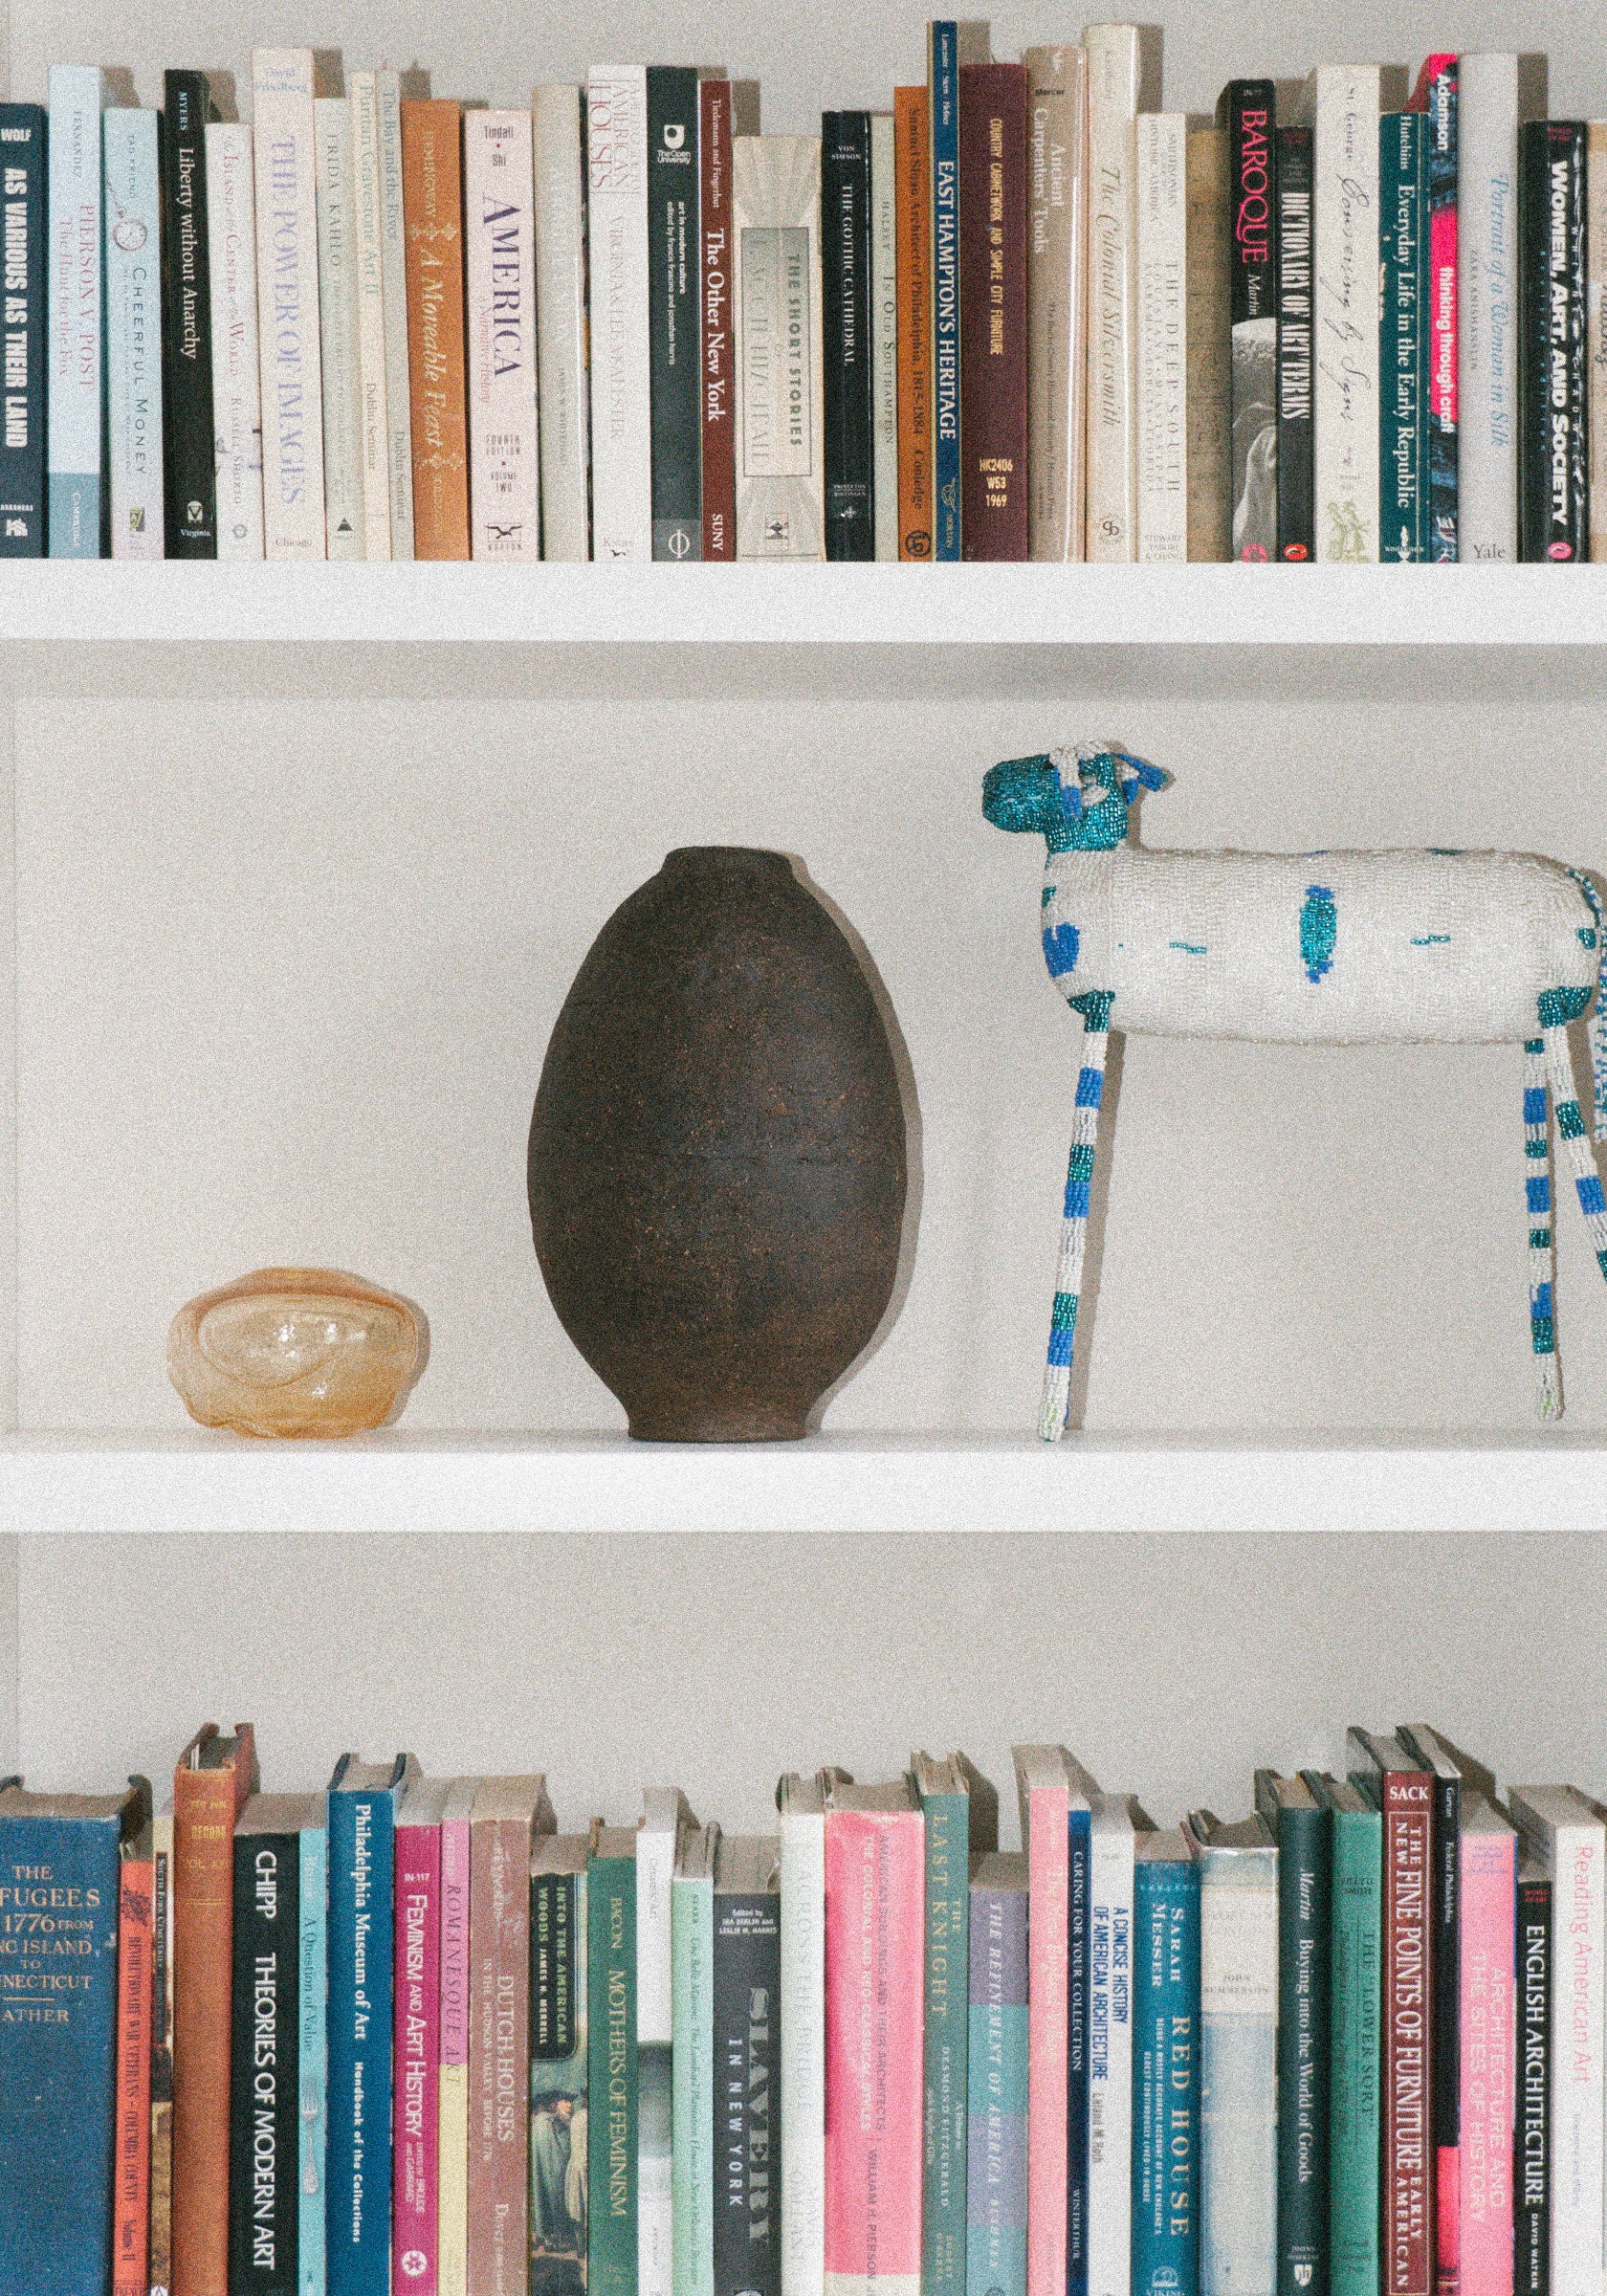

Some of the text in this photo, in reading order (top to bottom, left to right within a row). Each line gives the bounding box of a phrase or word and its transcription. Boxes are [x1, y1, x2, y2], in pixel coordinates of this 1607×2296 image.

[73, 110, 82, 178] FERNANDEZ
[179, 91, 187, 132] MYERS
[1437, 75, 1450, 150] Adamson
[1051, 143, 1066, 207] Ancient
[1236, 109, 1268, 264] BAROQUE
[176, 146, 200, 360] Liberty without Anarchy
[421, 248, 444, 268] A
[482, 191, 522, 379] AMERICA
[842, 184, 856, 366] THE GOTHIC CATHEDRAL
[1096, 167, 1121, 428] The Colonial Silversmith
[1282, 192, 1310, 289] DICTIONARY
[6, 167, 28, 450] AS VARIOUS AS THEIR LAND
[79, 205, 96, 392] PIERSON V. POST
[272, 136, 304, 504] THE POWER OF IMAGES
[421, 276, 448, 383] Moveable
[707, 228, 726, 423] The Other New York
[786, 254, 803, 447] THE SHORT STORIES
[938, 161, 957, 440] EAST HAMPTON'S HERITAGE
[1282, 296, 1310, 318] OF
[1282, 323, 1310, 355] ART
[1392, 184, 1416, 509] Everyday Life in the Early Republic
[1437, 267, 1454, 432] thinking through craft
[133, 267, 149, 476] CHEERFUL MONEY
[367, 383, 377, 421] Dublin
[424, 389, 448, 448] Feast
[1282, 359, 1310, 420] TERMS
[712, 513, 724, 551] SUNY
[863, 1835, 873, 1860] THE
[1390, 1785, 1429, 1800] SACK
[1397, 1821, 1408, 1866] NEW
[1410, 1825, 1421, 1866] THE
[6, 1913, 94, 1932] 1776 FROM
[11, 1866, 54, 1880] THE
[352, 1804, 371, 2040] Philadelphia Museum of Art
[932, 1816, 947, 2018] LAST KNIGHT
[953, 1898, 962, 1934] THE
[1443, 1843, 1454, 1924] Federal Philadelphia
[21, 1959, 42, 1969] TO
[484, 1959, 493, 1971] IN
[557, 1886, 566, 2043] INTO THE AMERICAN
[863, 1936, 872, 1965] AND
[1071, 1851, 1085, 2072] CARING FOR YOUR COLLECTION
[1092, 1906, 1109, 2081] OF AMERICAN ARCHITECTURE
[1113, 1906, 1127, 2024] A CONCISE HISTORY
[1152, 1903, 1167, 1986] MESSER
[1169, 1907, 1184, 1982] SARAH
[1526, 1925, 1546, 2020] ENGLISH
[1569, 1846, 1594, 2084] Reading American Art
[253, 1850, 275, 2272] CHIPP THEORIES OF MODERN ART
[406, 1894, 429, 2137] FEMINISM AND ART HISTORY
[483, 2001, 492, 2049] HUDSON
[483, 2053, 492, 2091] VALLEY
[496, 1975, 515, 2143] DUTCH HOUSES
[608, 1895, 627, 2217] BACON MOTHERS OF FEMINISM
[1295, 1938, 1314, 2183] Buying into the World of Goods
[1396, 1869, 1423, 2170] FINE POINTS OF FURNITURE
[729, 2038, 744, 2206] IN NEW YORK
[749, 1987, 769, 2244] SLAVERY
[941, 2045, 950, 2112] DESMOND
[1171, 2017, 1190, 2237] RED HOUSE
[1490, 1966, 1506, 2208] ARCHITECTURE AND
[1525, 2028, 1546, 2206] ARCHITECTURE
[352, 2062, 364, 2242] Handbook of the Collections
[1410, 2175, 1421, 2240] EARLY
[1397, 2175, 1408, 2287] AMERICAN
[1530, 2212, 1539, 2246] DAVID
